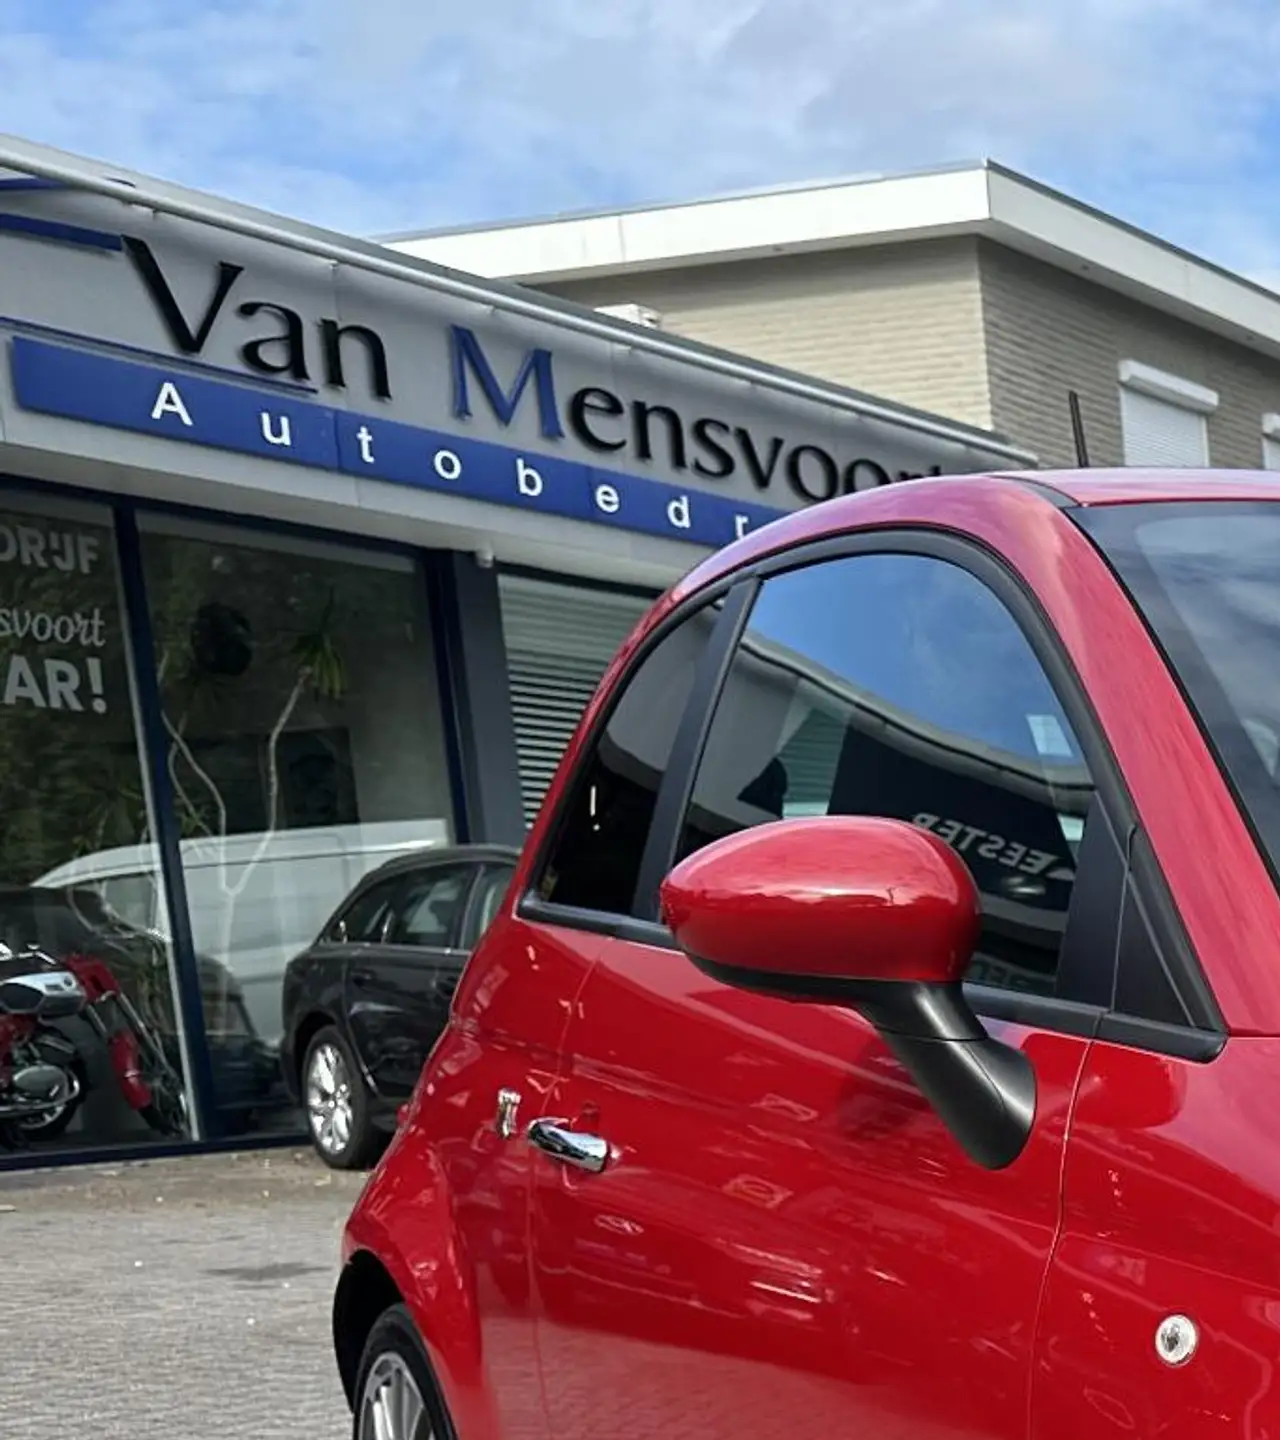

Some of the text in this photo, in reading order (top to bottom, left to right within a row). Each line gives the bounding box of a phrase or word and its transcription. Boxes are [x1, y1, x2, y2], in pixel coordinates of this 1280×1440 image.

[121, 234, 941, 502] Van Mensvoo
[150, 381, 749, 538] Autobedr
